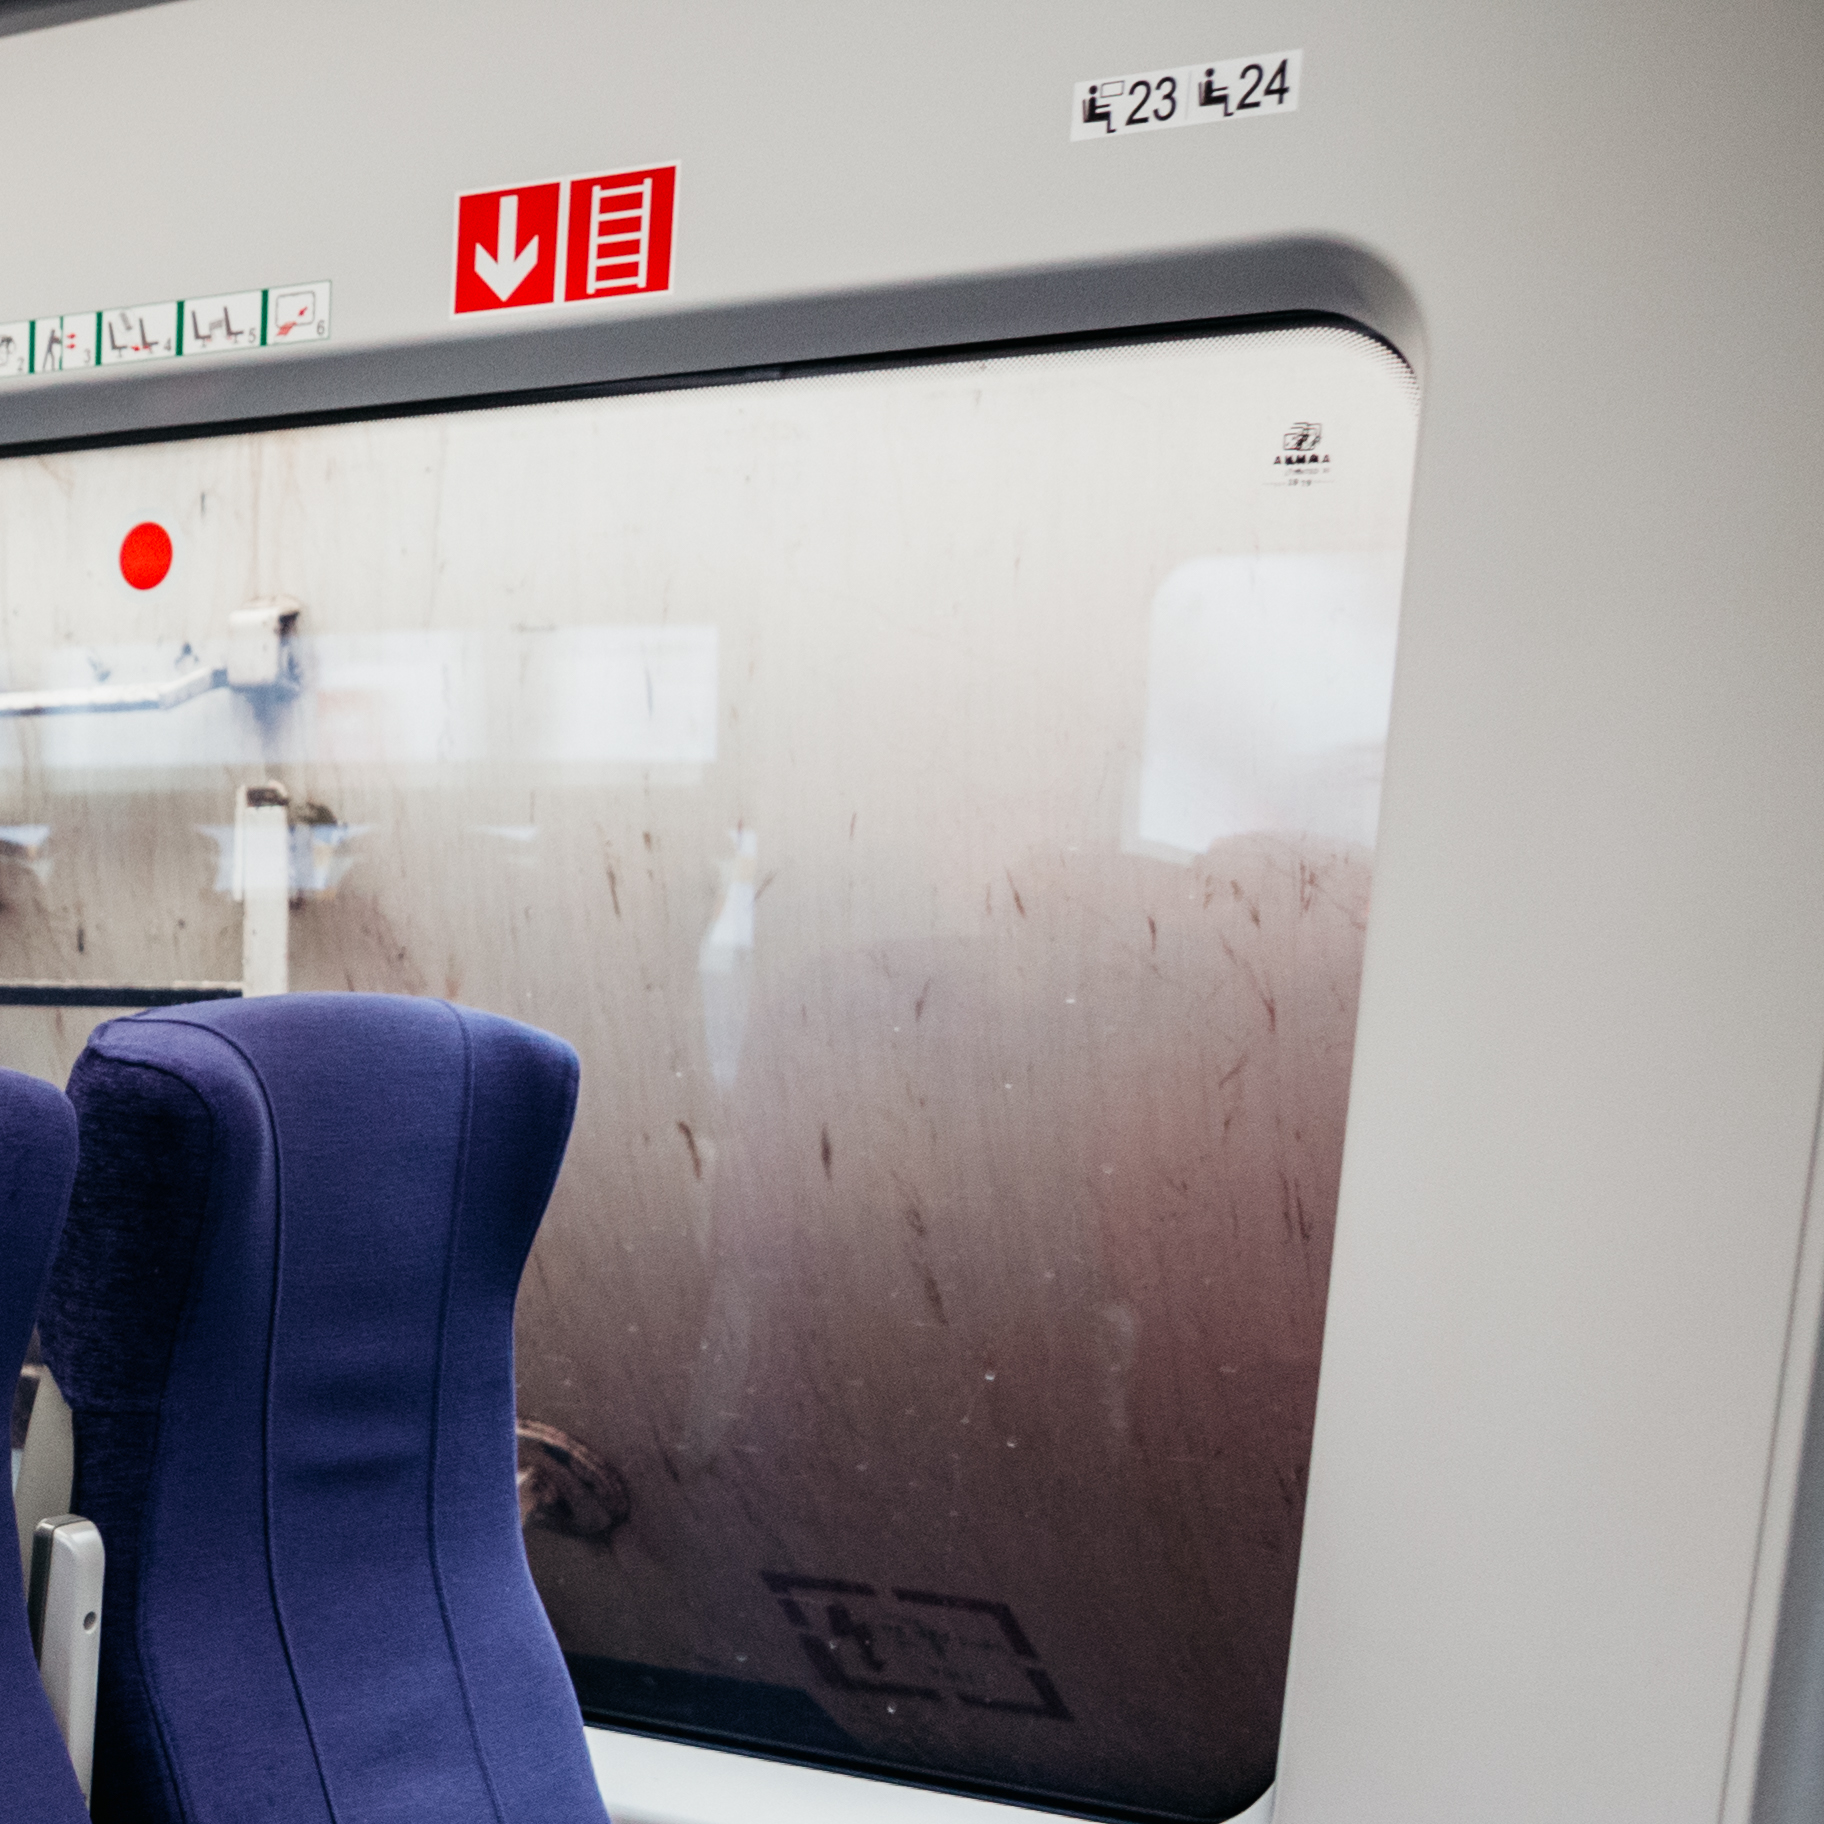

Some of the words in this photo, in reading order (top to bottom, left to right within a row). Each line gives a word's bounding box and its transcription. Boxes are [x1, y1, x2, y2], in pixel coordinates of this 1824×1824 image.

[1125, 76, 1177, 126] 23
[1236, 58, 1290, 111] 24
[16, 357, 26, 372] 2
[84, 348, 92, 364] 3
[163, 337, 172, 352] 4
[248, 328, 257, 344] 5
[316, 319, 326, 336] 6
